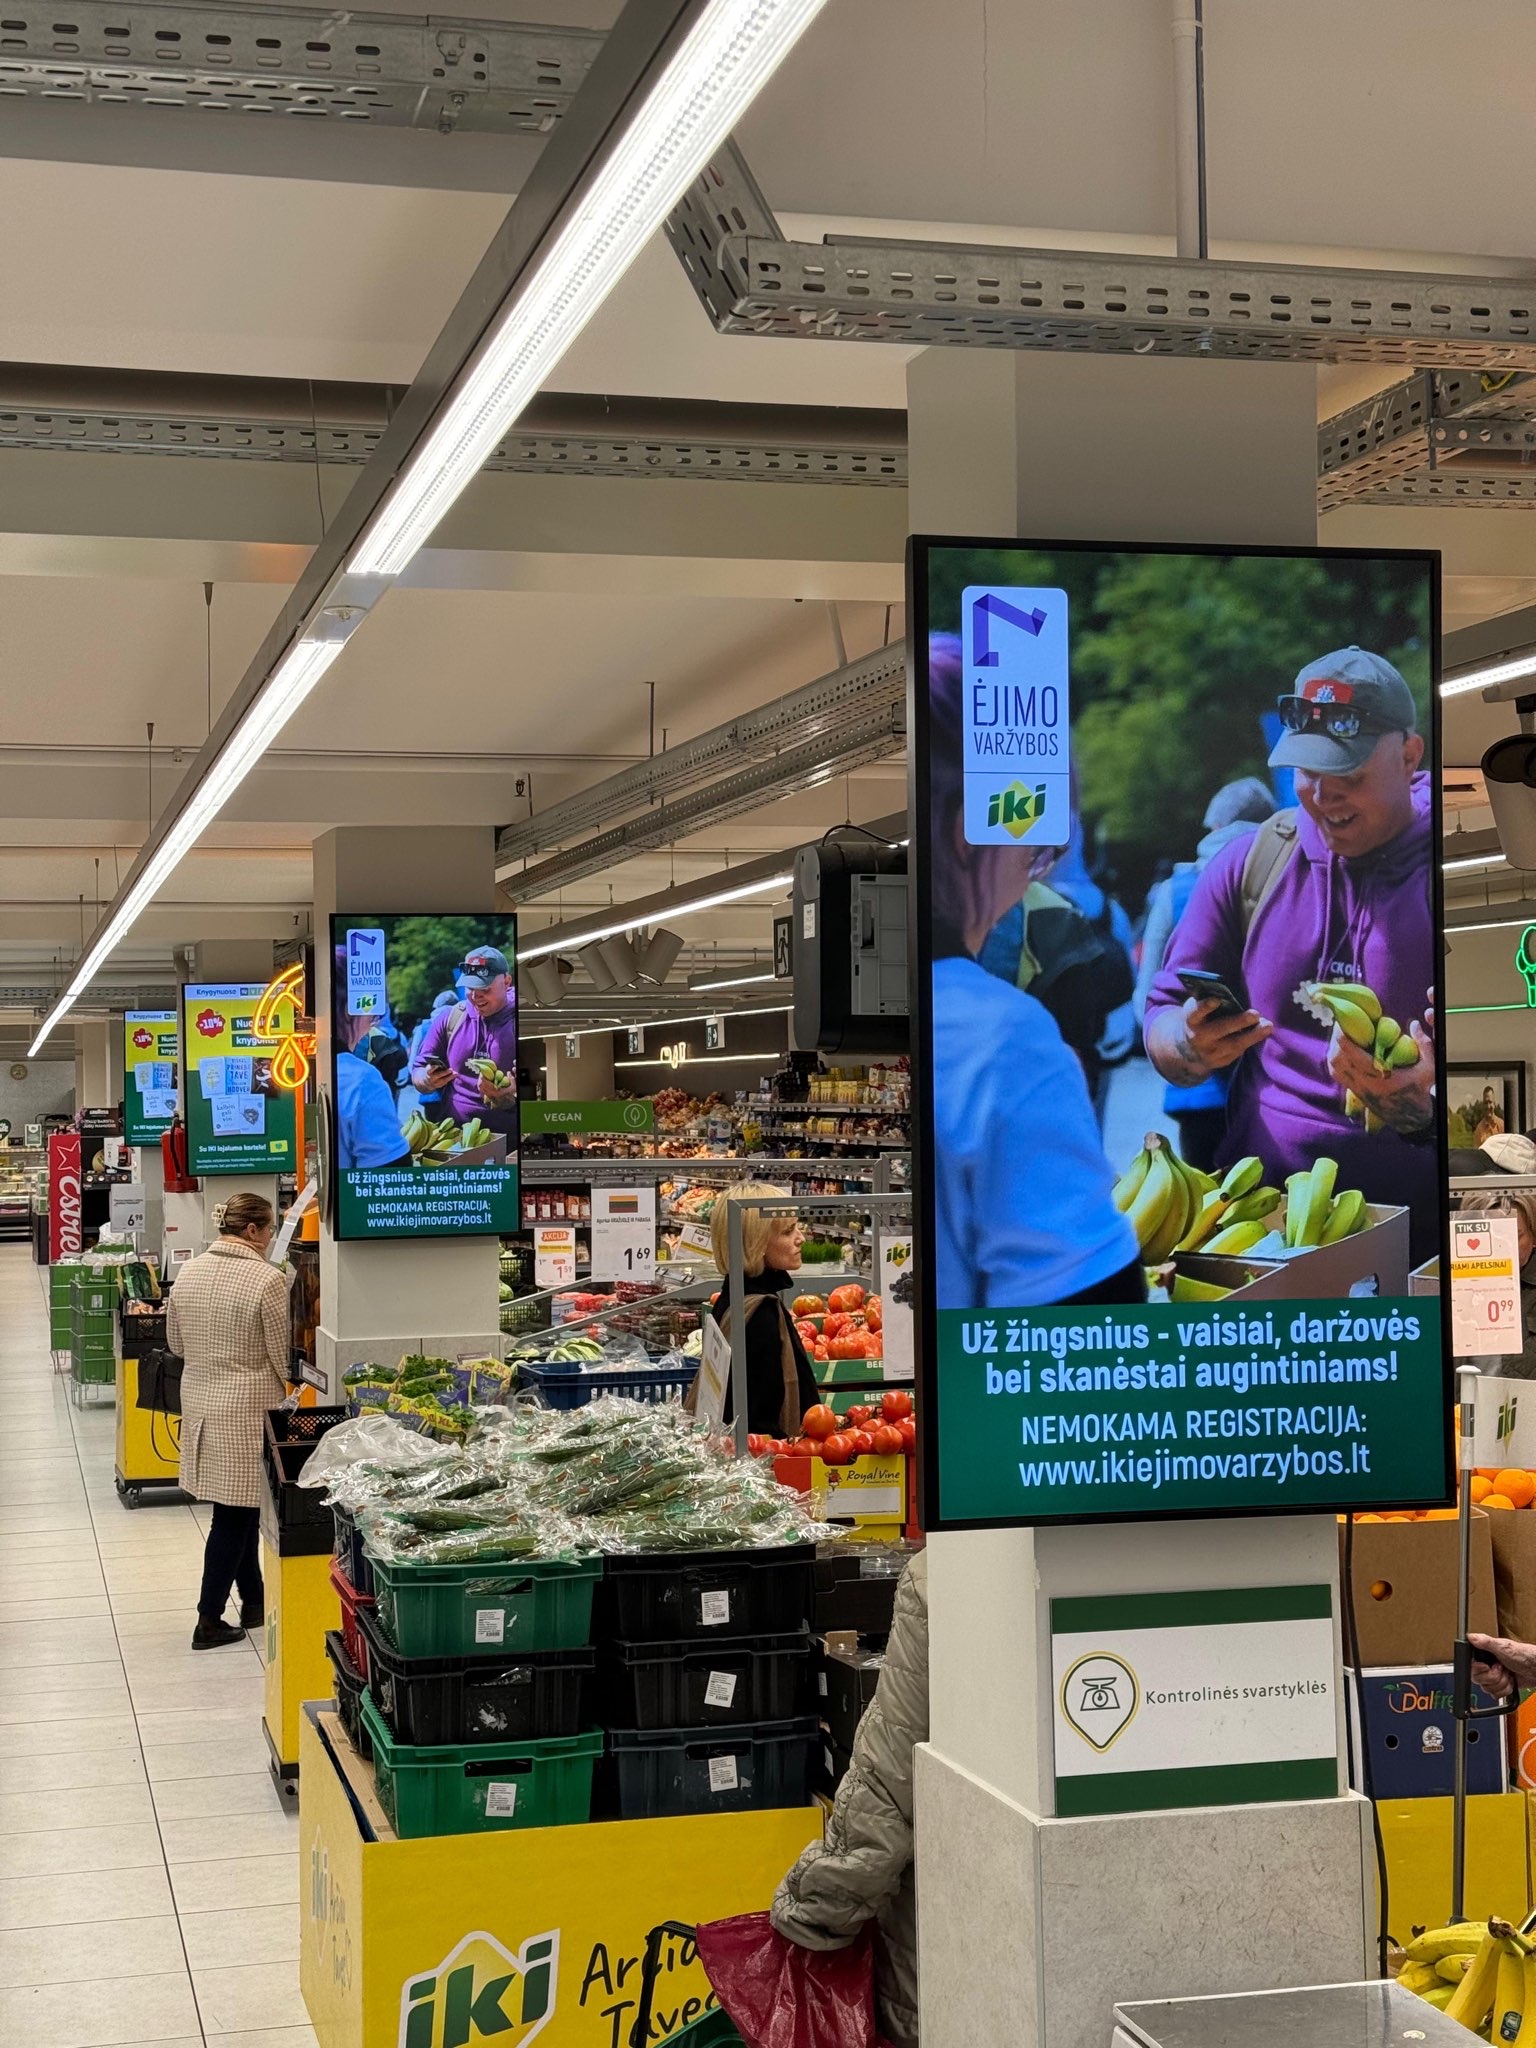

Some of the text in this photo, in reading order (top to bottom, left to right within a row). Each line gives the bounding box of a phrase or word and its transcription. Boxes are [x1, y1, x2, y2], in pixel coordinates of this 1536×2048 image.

[973, 678, 1058, 728] ĖJIMO
[974, 729, 1058, 756] VARŽYBOS
[988, 783, 1046, 828] iki
[351, 961, 381, 976] ĖJIMO
[351, 976, 382, 986] VARŽYBOS
[543, 1112, 582, 1122] VEGAN
[348, 1172, 361, 1184] Už
[363, 1171, 413, 1185] žingsnius
[423, 1170, 461, 1183] vaisiai,
[463, 1168, 510, 1181] daržovės
[356, 1183, 502, 1197] bei skanėstai augintiniams!
[368, 1200, 491, 1214] NEMOKAMA REGISTRACIJA:
[367, 1212, 492, 1228] www.ikiejimovarzybos.lt
[1457, 1222, 1489, 1232] TIK SU
[543, 1231, 568, 1241] AKCIJA
[886, 1242, 912, 1263] iki
[1471, 1261, 1507, 1270] APELSINAI
[962, 1319, 998, 1354] Už
[1006, 1317, 1150, 1359] žingsnius
[1177, 1313, 1282, 1350] vaisiai,
[1290, 1308, 1420, 1345] daržovės
[986, 1351, 1398, 1395] bei skanėstai augintiniams!
[1022, 1405, 1367, 1445] NEMOKAMA REGISTRACIJA:
[1019, 1442, 1371, 1489] www.ikiejimovarzybos.lt
[846, 1467, 900, 1484] Royal Vine
[1145, 1680, 1327, 1705] Kontrolinės svarstyklės
[405, 1938, 553, 2048] iki
